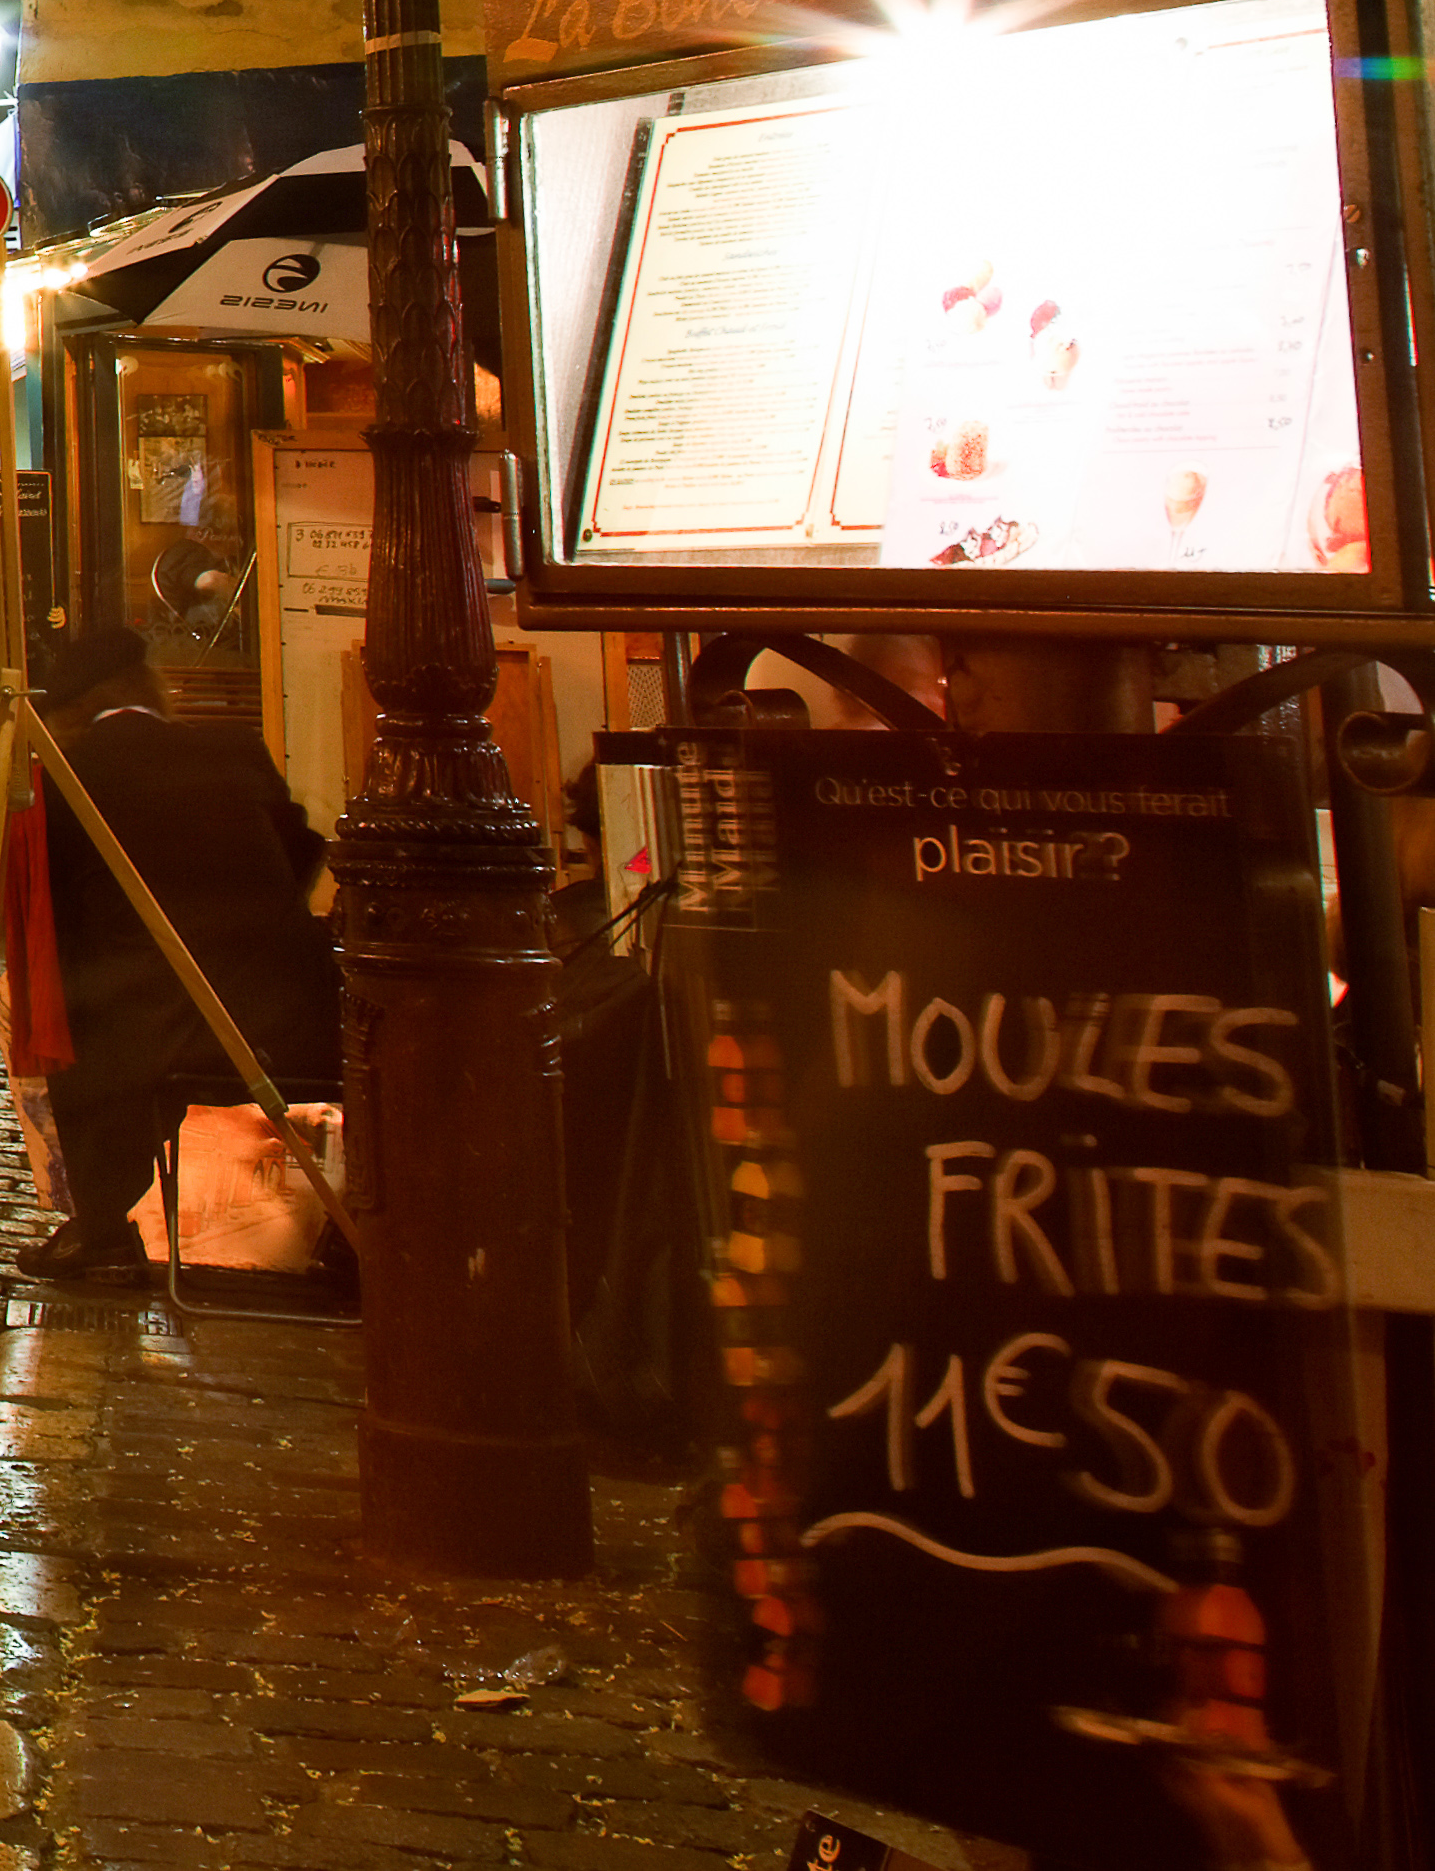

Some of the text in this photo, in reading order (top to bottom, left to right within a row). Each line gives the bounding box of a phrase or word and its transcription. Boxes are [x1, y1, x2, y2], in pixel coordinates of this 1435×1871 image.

[677, 742, 709, 912] Minute
[814, 775, 1233, 818] Qu'est-ce qui vous ferait
[913, 825, 1083, 882] plaisir
[828, 969, 1298, 1118] MOULES
[926, 1139, 1340, 1309] FRITES
